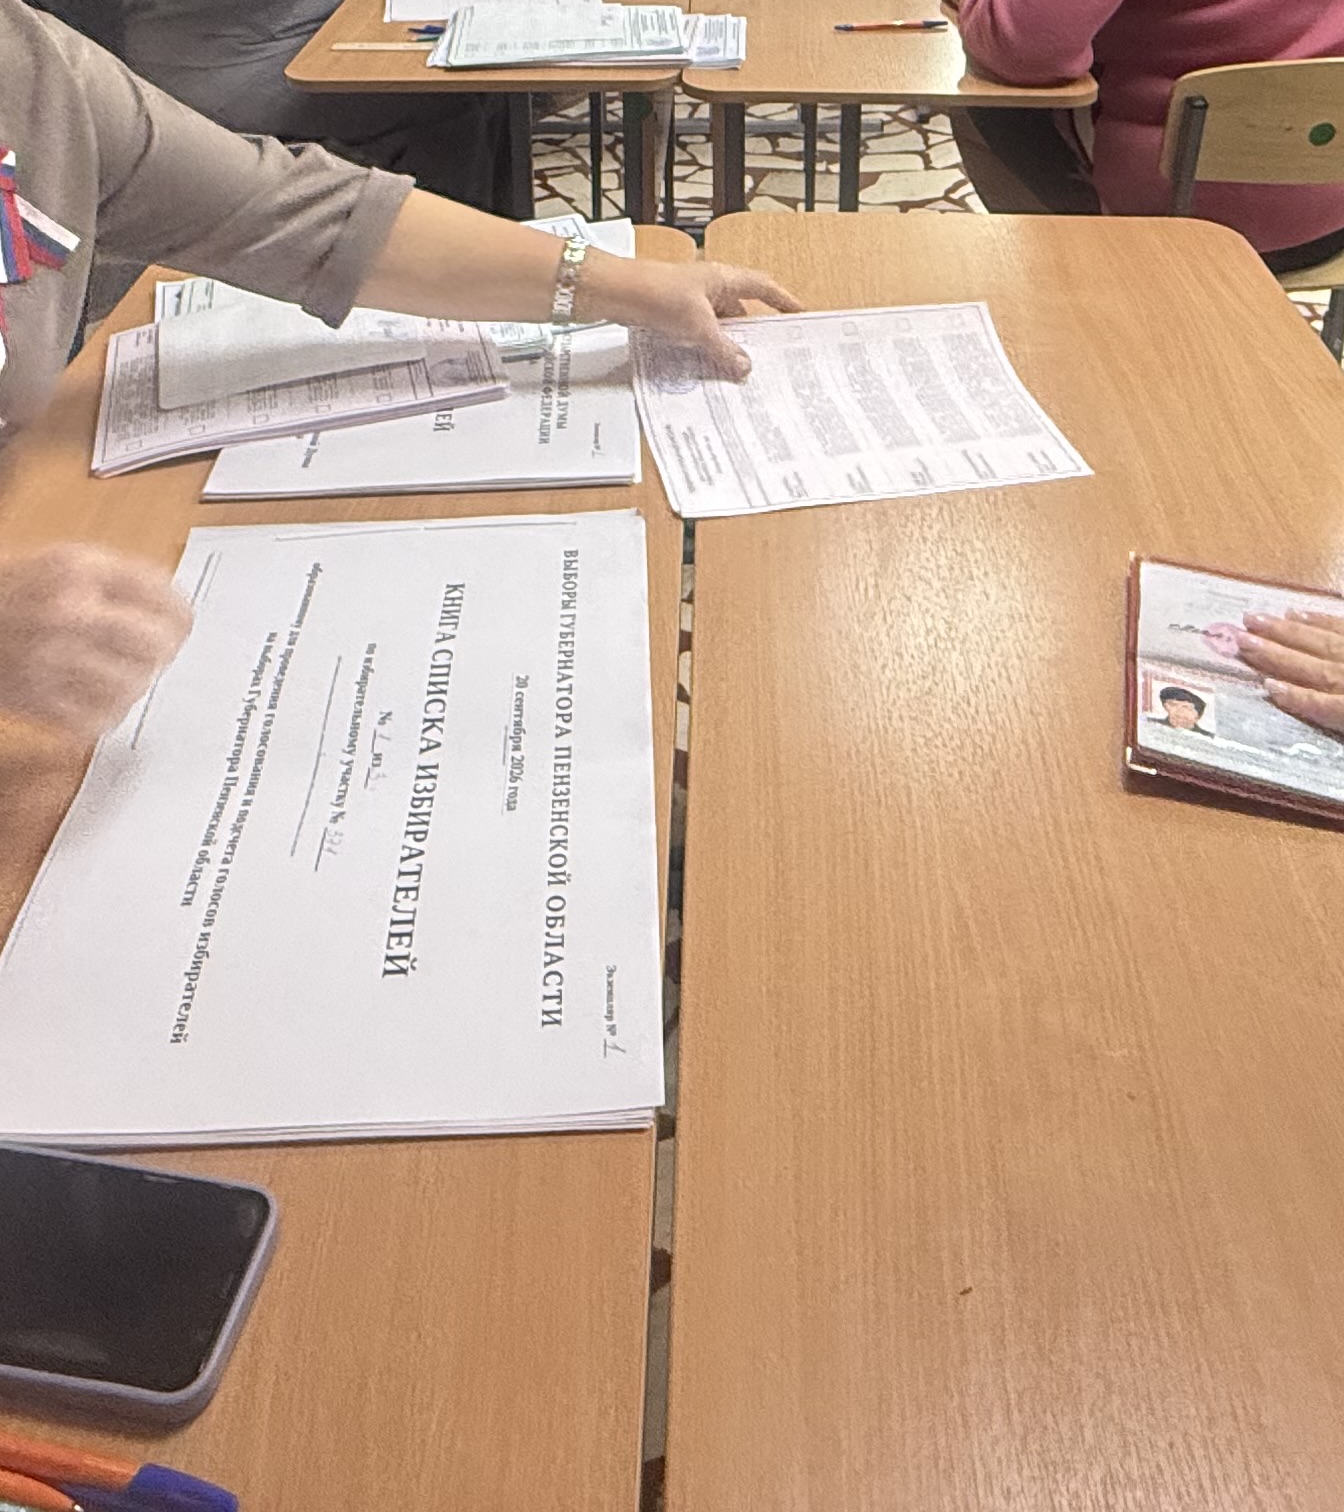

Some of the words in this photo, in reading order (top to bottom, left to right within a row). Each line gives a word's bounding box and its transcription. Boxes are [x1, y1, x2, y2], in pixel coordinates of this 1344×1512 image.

[537, 385, 553, 444] ФЕДЕРАЦИИ
[556, 400, 569, 429] ДУМЫ
[561, 550, 578, 609] ВЫБОРЫ
[434, 583, 465, 644] КНИГА
[267, 648, 294, 710] проведения
[366, 643, 377, 656] по
[555, 613, 576, 738] ГУБЕРНАТОРА
[341, 656, 375, 756] избирательному
[418, 648, 454, 755] СПИСКА
[515, 675, 529, 688] 20
[226, 689, 262, 773] Губернатора
[377, 711, 393, 726] №
[509, 691, 526, 752] сентября
[244, 713, 275, 796] голосования
[330, 759, 354, 809] участку
[371, 752, 383, 768] из
[508, 754, 525, 785] 2026
[201, 775, 239, 847] Пензенской
[241, 798, 253, 807] и
[329, 810, 346, 824] №
[505, 785, 519, 811] года
[547, 746, 573, 886] ПЕНЗЕНСКОЙ
[221, 809, 249, 865] подсчета
[180, 849, 211, 907] области
[202, 868, 229, 928] голосов
[382, 763, 439, 978] ИЗБИРАТЕЛЕЙ
[170, 931, 211, 1044] избирателей
[541, 895, 567, 1028] ОБЛАСТИ
